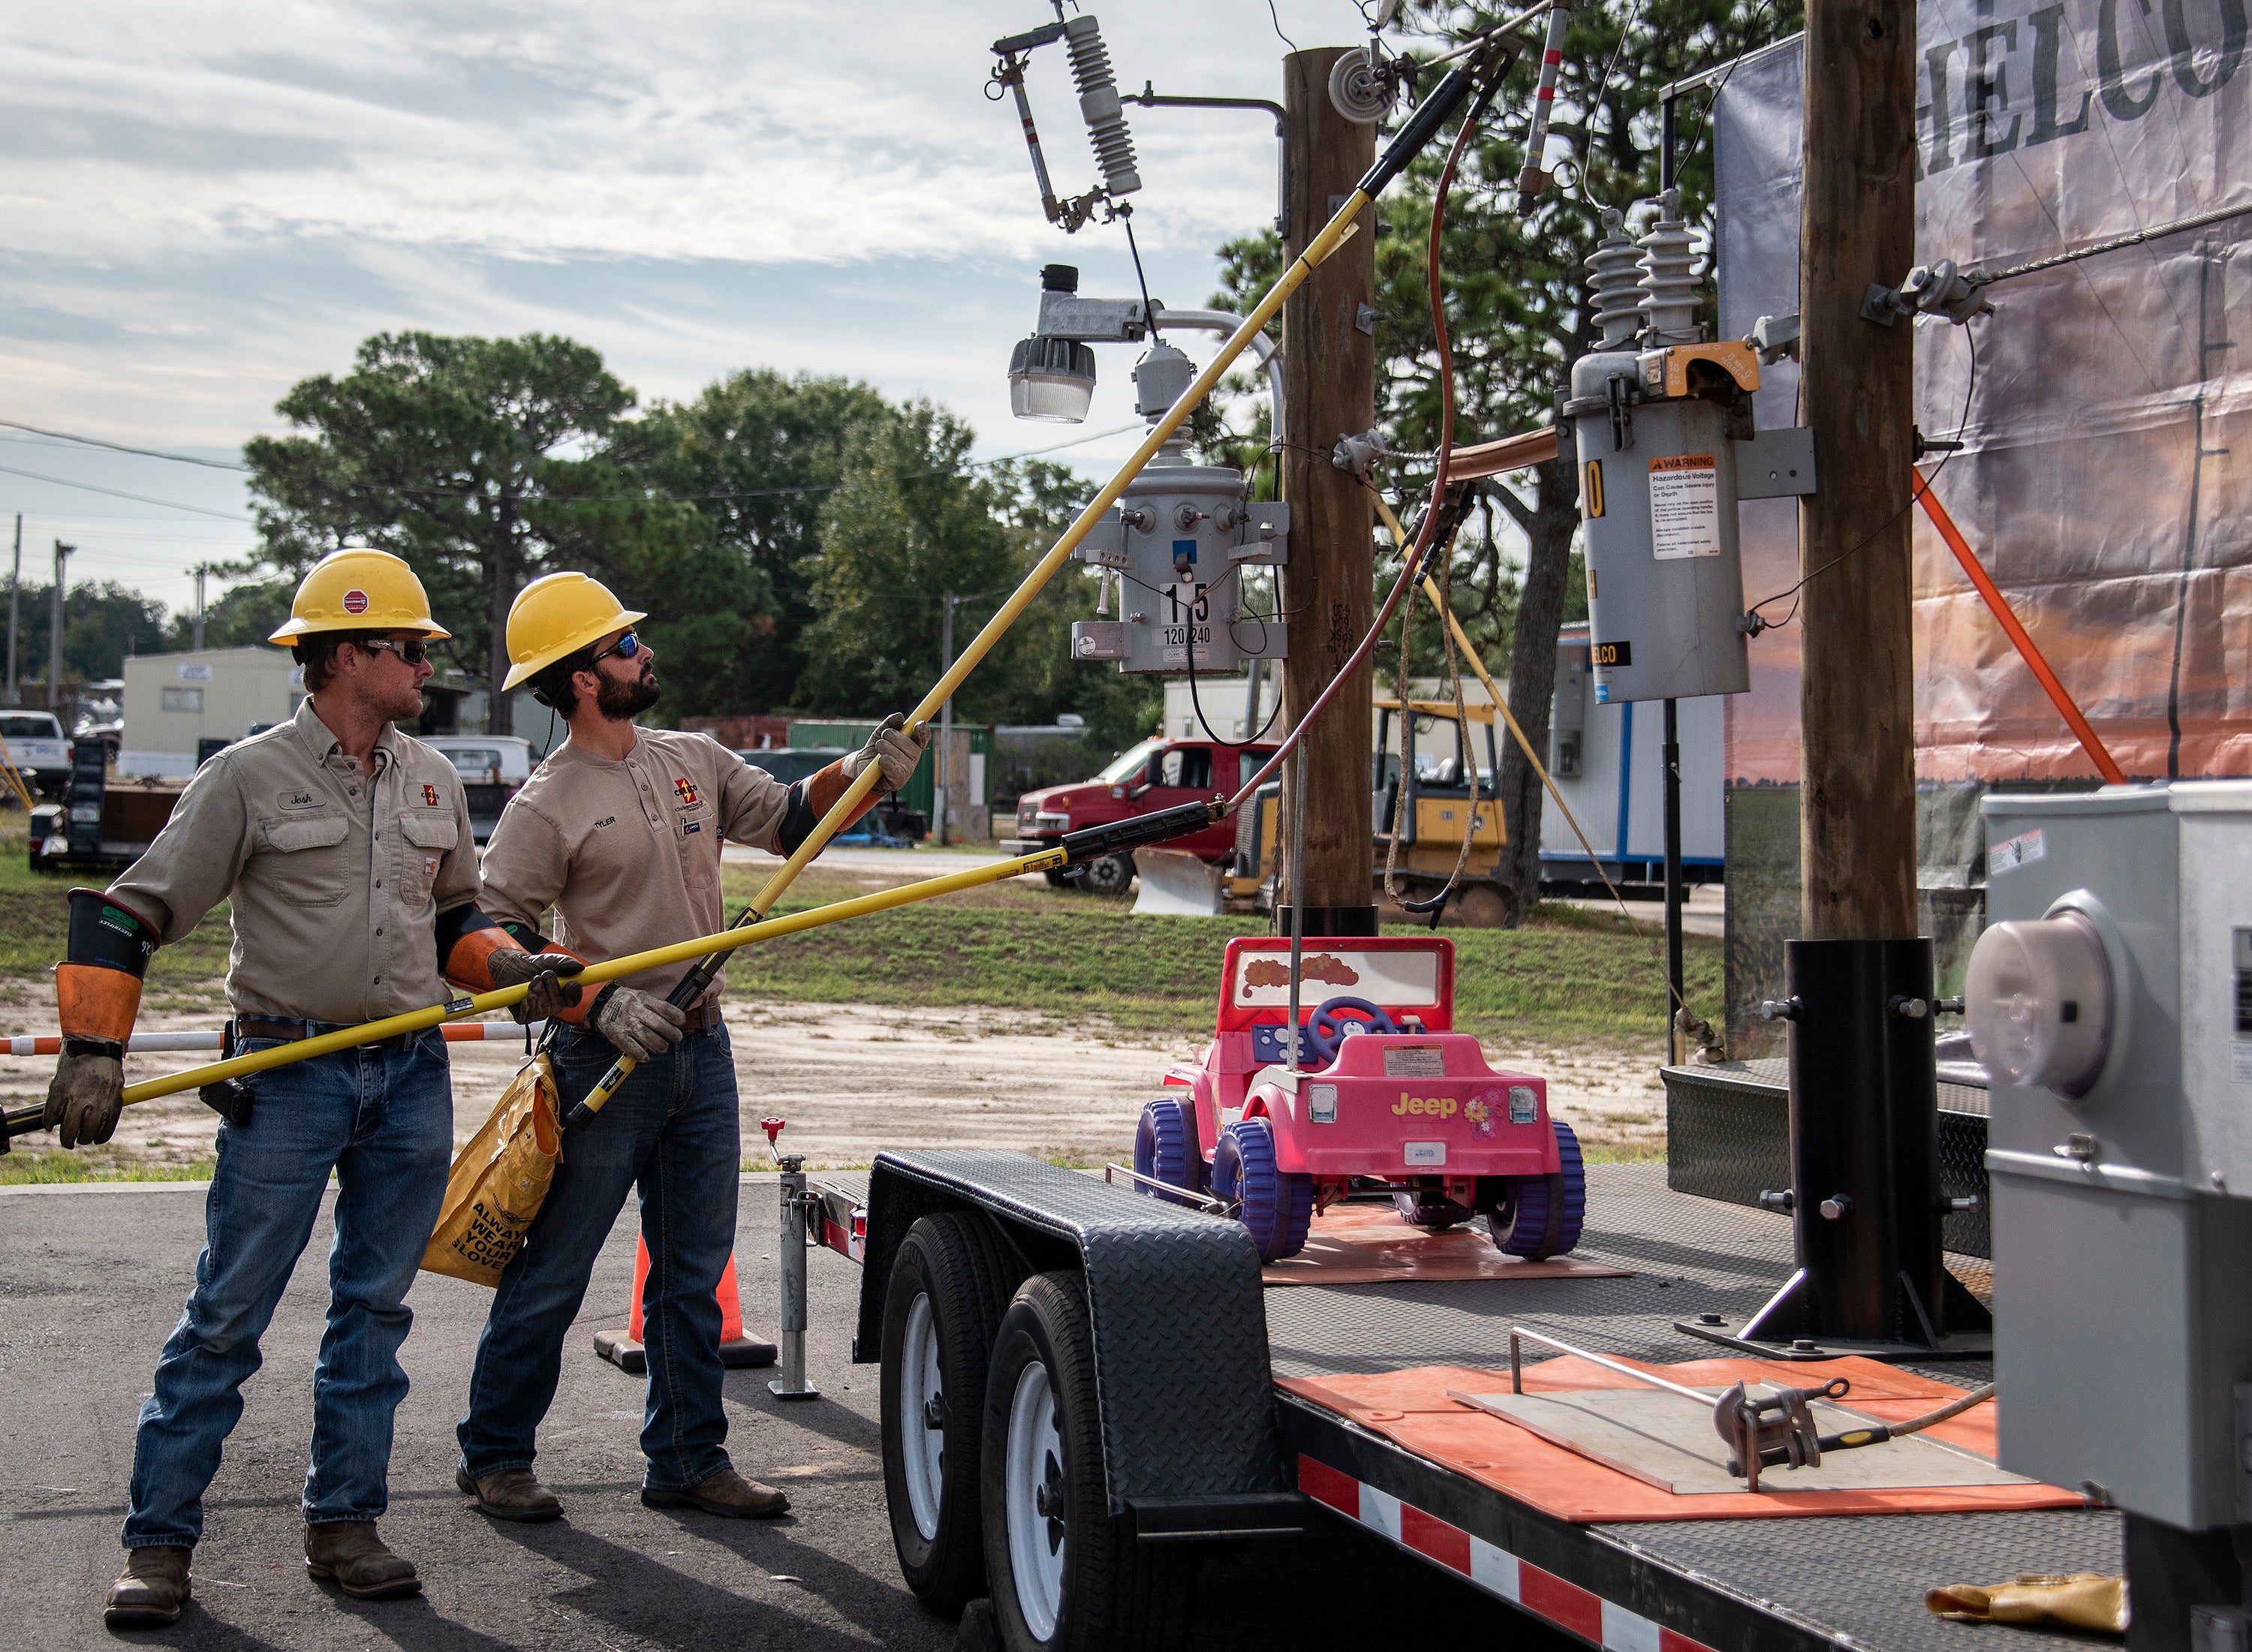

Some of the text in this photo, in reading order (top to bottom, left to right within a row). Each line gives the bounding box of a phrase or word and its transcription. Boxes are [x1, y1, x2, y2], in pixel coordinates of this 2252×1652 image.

[1663, 456, 1713, 468] WARNING
[1653, 474, 1691, 482] Hazardous
[291, 793, 313, 805] Josh
[594, 816, 616, 829] TYLER
[99, 919, 133, 937] ELECTRIFLEX
[1391, 1092, 1458, 1119] Jeep
[473, 1202, 523, 1240] ALWAY
[471, 1218, 520, 1250] WEAR
[465, 1229, 512, 1261] YOUR
